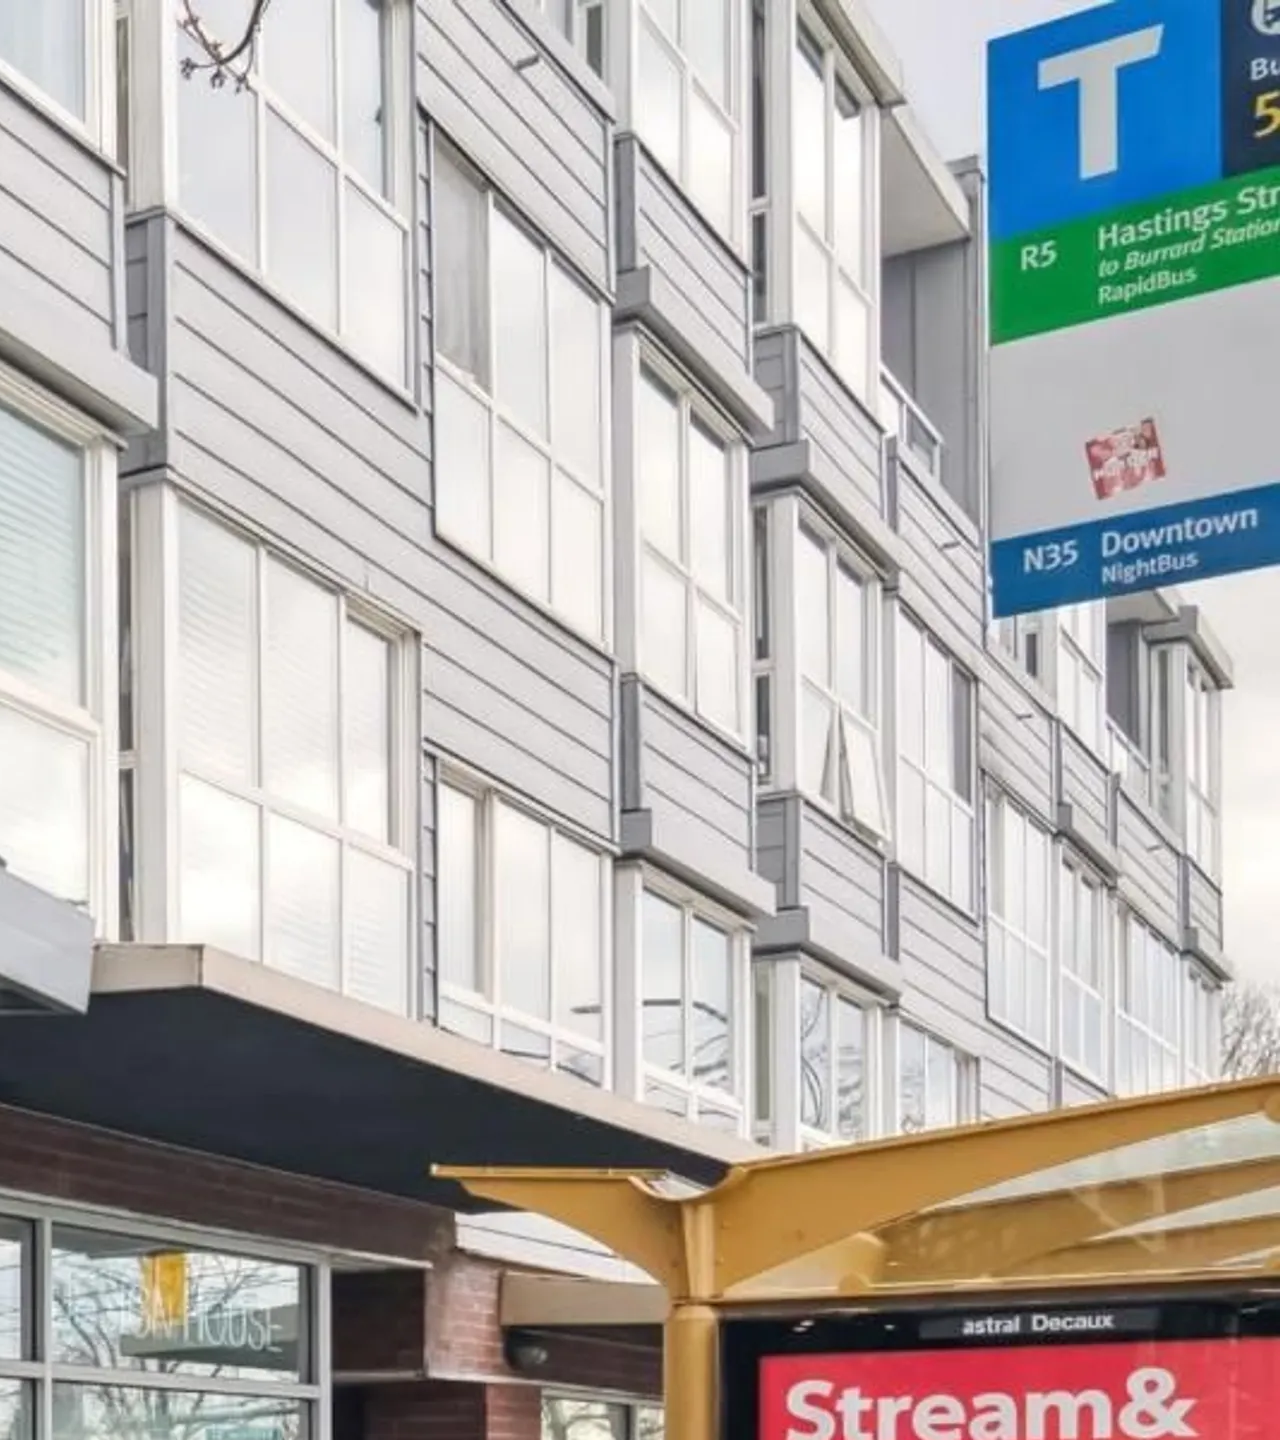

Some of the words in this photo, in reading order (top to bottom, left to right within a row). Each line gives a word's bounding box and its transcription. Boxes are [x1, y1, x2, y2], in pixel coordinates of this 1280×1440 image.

[1037, 24, 1164, 181] T
[1020, 240, 1057, 272] R5
[1097, 199, 1228, 251] Hastings
[1097, 258, 1120, 279] to
[1123, 231, 1207, 271] Burrard
[1098, 267, 1198, 305] RapidBus
[1022, 537, 1080, 575] N35
[1100, 507, 1259, 558] Downtown
[1100, 551, 1200, 585] NightBus
[962, 1315, 1020, 1335] astral
[1030, 1313, 1115, 1332] Decaux
